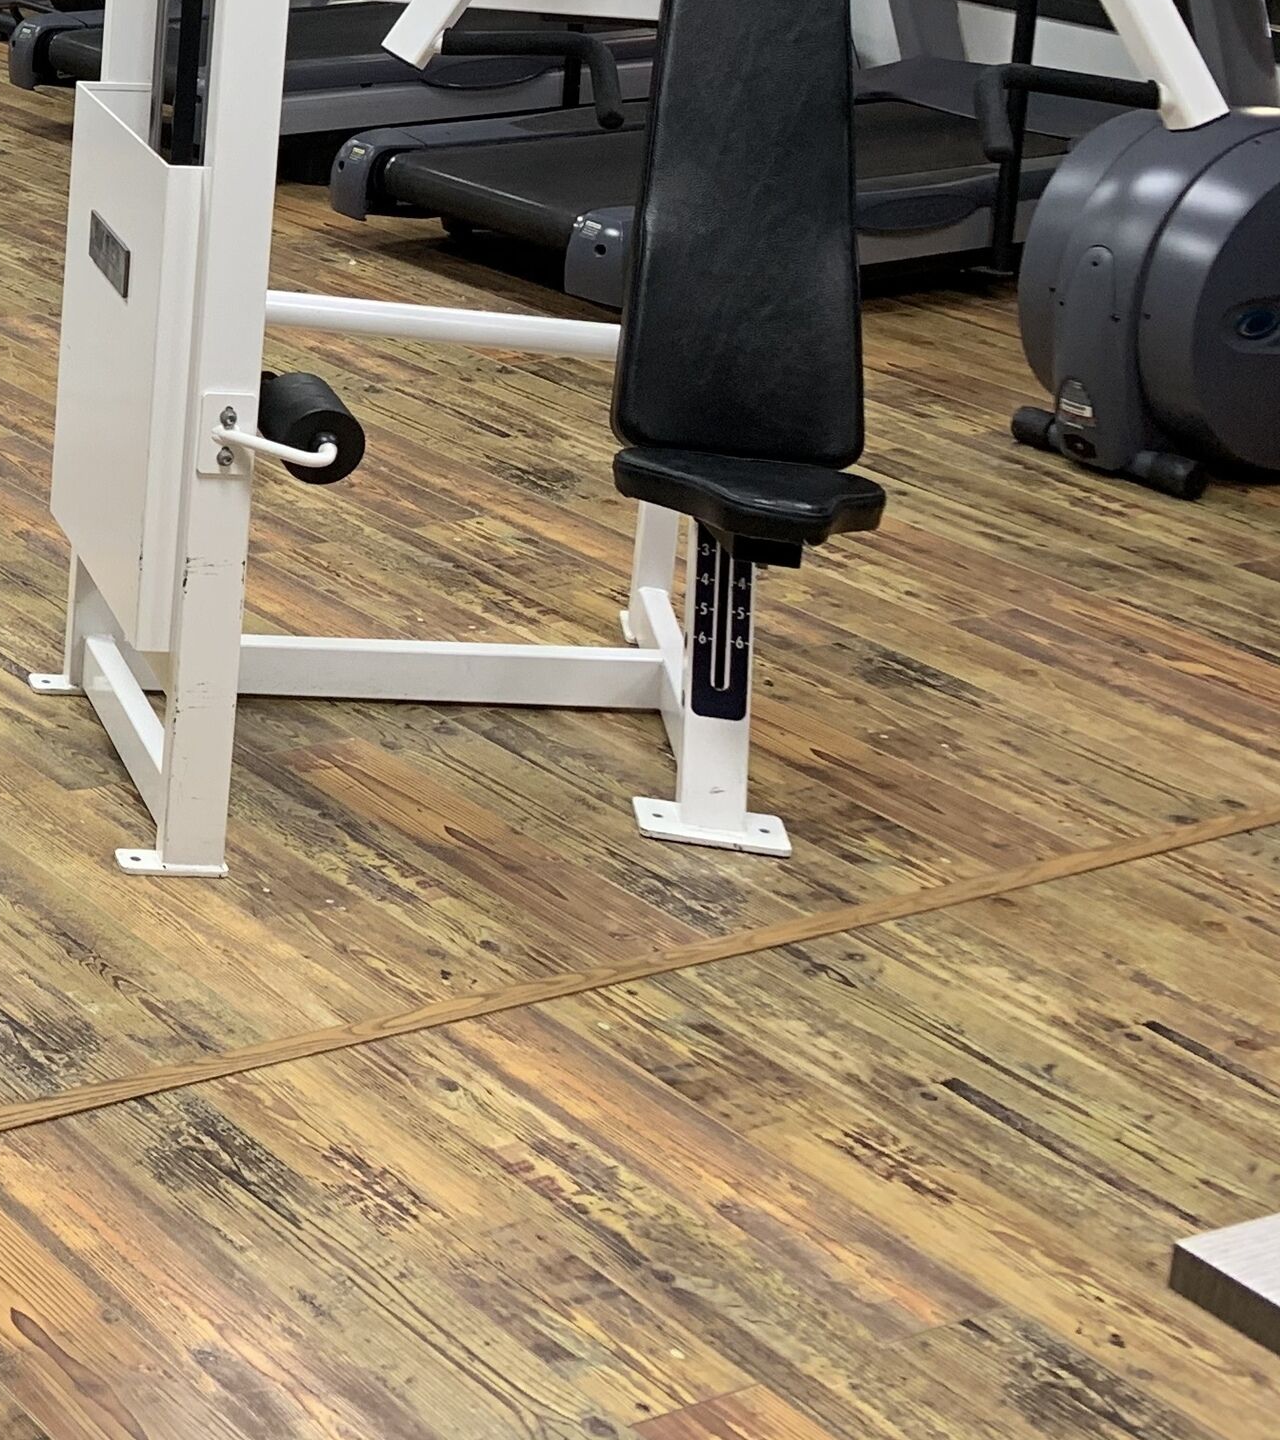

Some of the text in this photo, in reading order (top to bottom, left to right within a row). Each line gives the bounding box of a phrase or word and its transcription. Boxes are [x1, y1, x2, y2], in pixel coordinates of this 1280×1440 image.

[701, 543, 710, 556] 3
[700, 572, 709, 586] 4
[738, 577, 747, 590] 4
[700, 602, 709, 615] 5
[737, 606, 746, 620] 5
[698, 631, 707, 644] 6
[735, 635, 745, 649] 6
